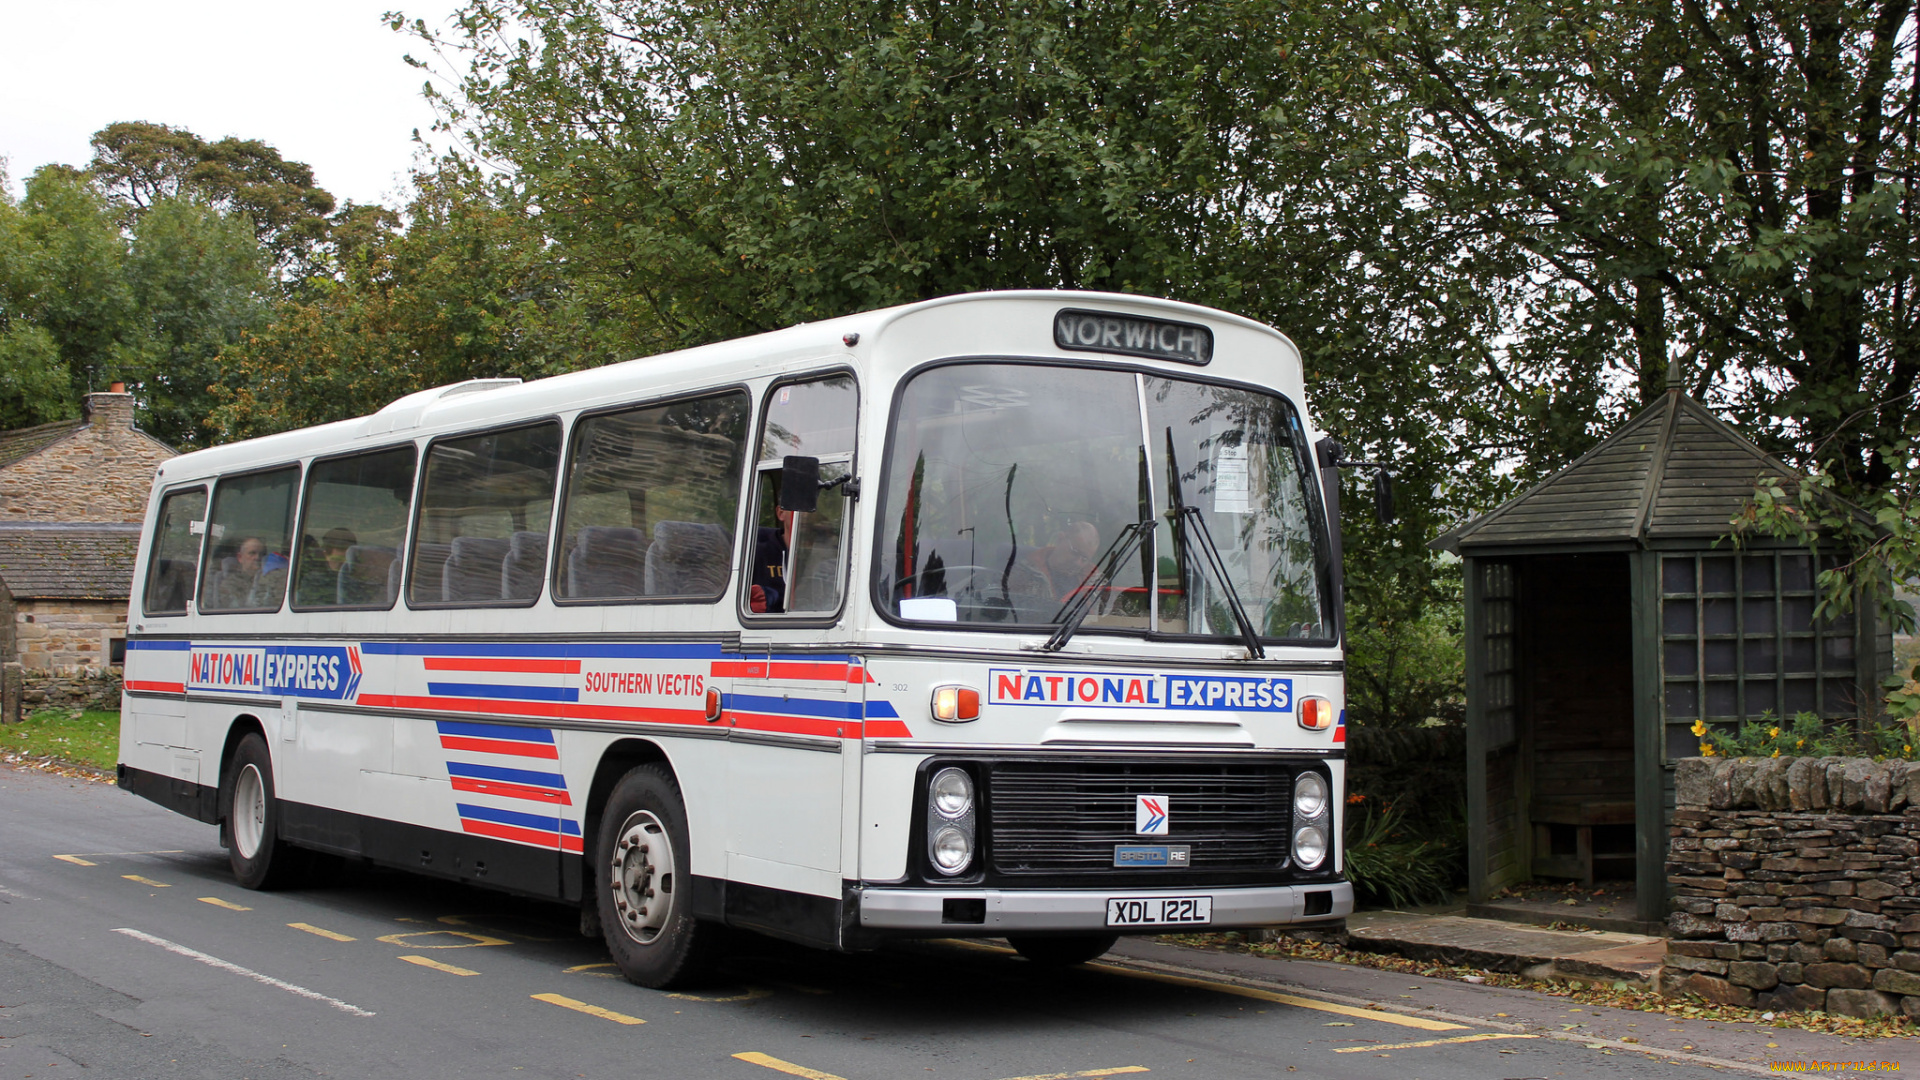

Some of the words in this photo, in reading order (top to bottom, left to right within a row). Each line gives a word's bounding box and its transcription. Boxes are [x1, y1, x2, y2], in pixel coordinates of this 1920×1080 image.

[1058, 316, 1196, 352] NORWICH
[190, 652, 261, 686] NATIONAL
[264, 653, 341, 692] EXPRESS
[585, 671, 653, 694] SOUTHERN
[656, 673, 704, 697] VECTIS
[892, 683, 909, 692] 302
[998, 674, 1159, 705] NATIONAL
[1170, 679, 1289, 708] EXPRESS
[1120, 850, 1165, 861] BRISTOL
[1170, 851, 1186, 861] RE
[1114, 901, 1156, 923] XDL
[1160, 899, 1206, 922] 122L
